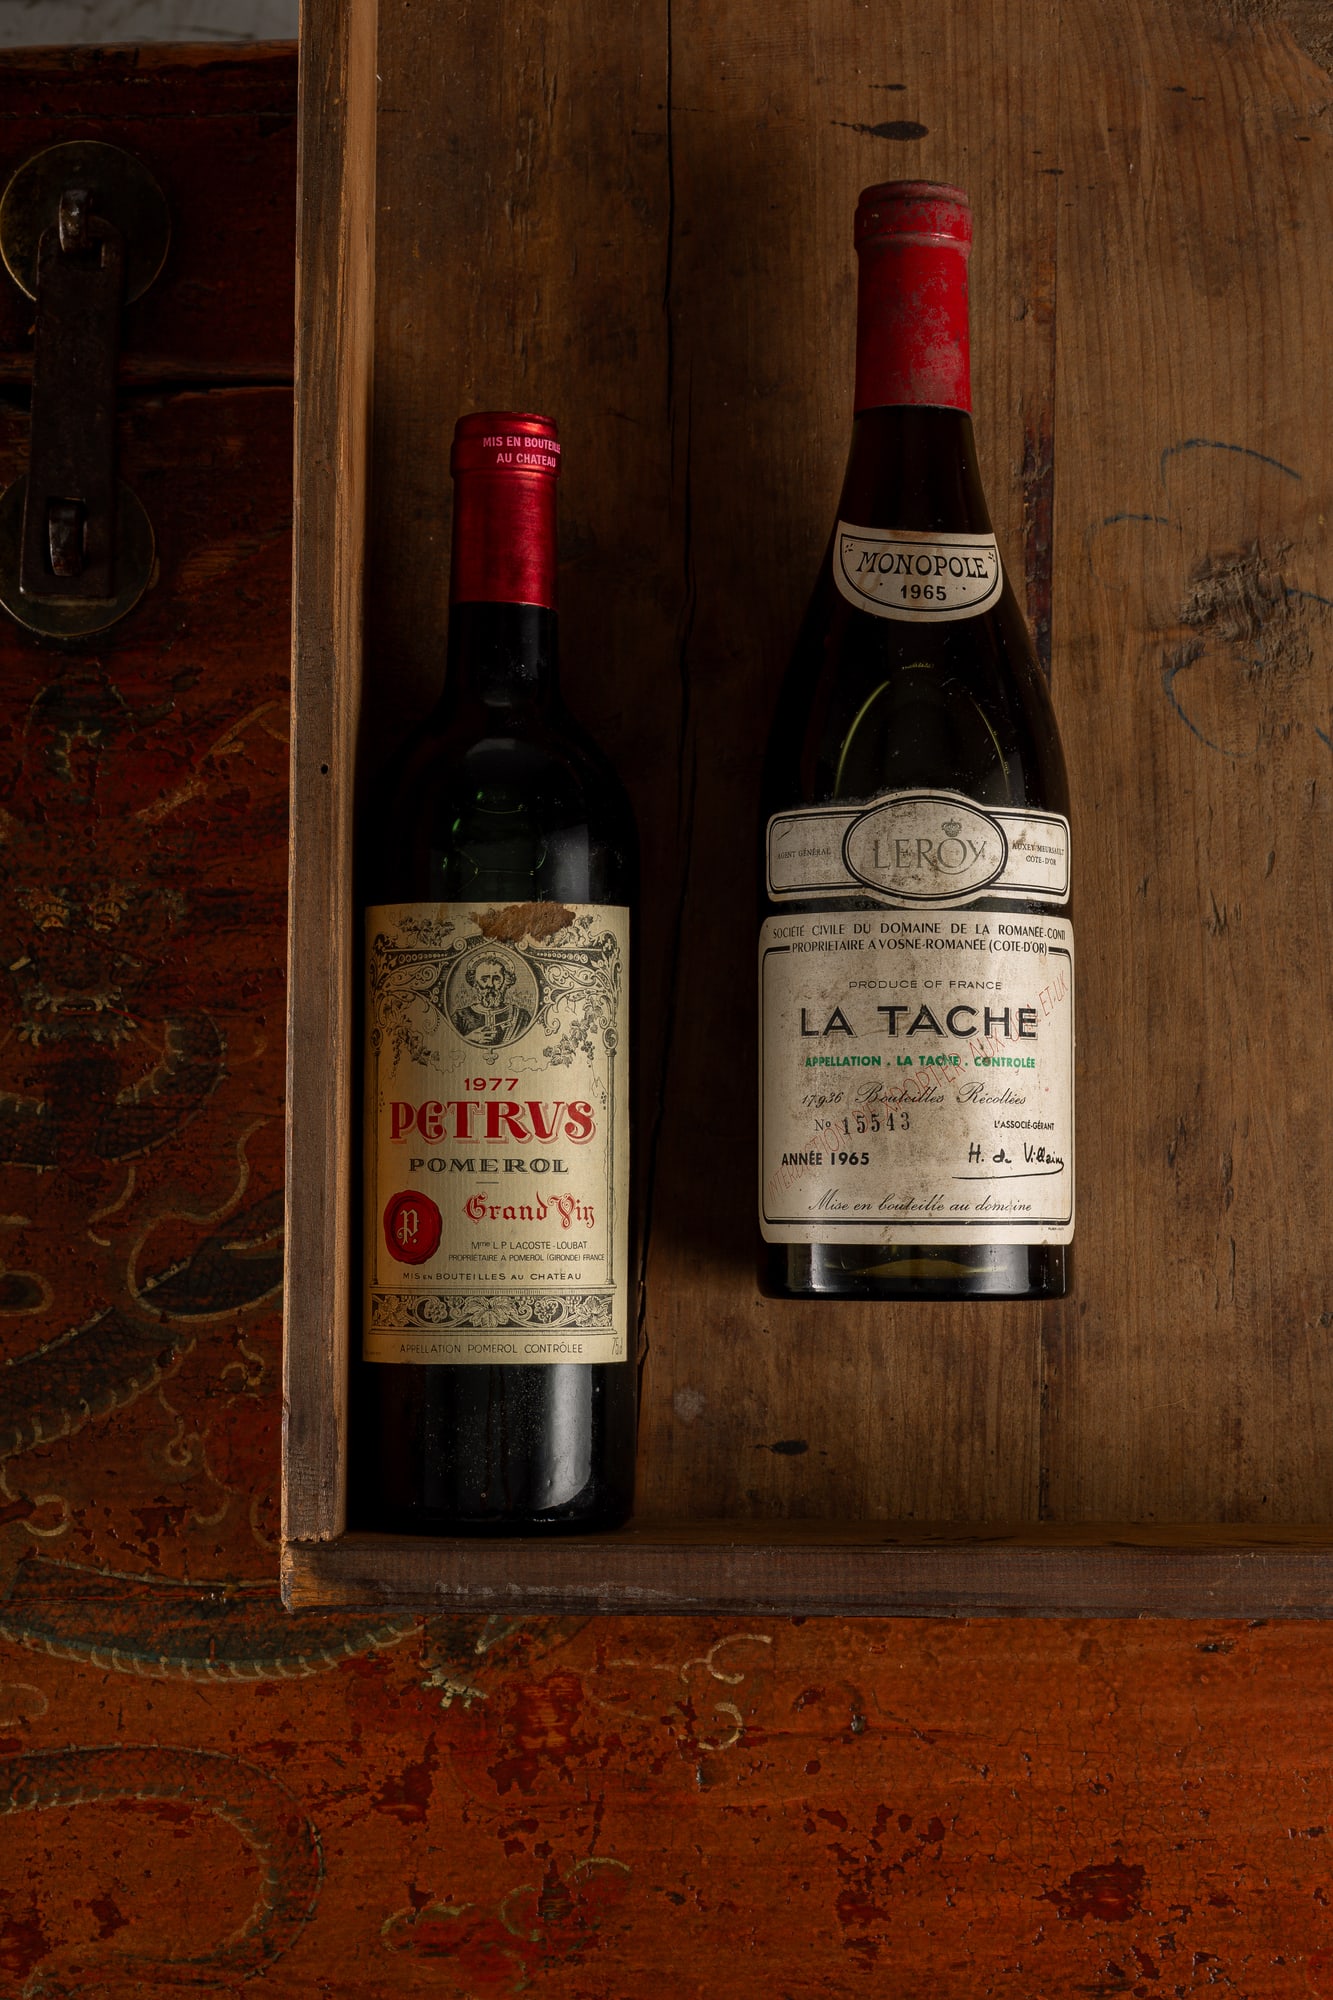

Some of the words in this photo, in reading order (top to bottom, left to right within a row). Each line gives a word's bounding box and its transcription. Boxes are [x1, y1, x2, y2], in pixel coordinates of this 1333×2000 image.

[483, 436, 503, 447] MIS
[506, 436, 521, 447] EN
[496, 453, 512, 464] AU
[516, 453, 556, 467] CHATEAU
[855, 551, 989, 579] MONOPOLE
[900, 584, 947, 600] 1965
[777, 850, 797, 860] AGENT
[872, 837, 988, 875] LEROY
[773, 925, 805, 939] SOCIÉTÉ
[811, 923, 846, 936] CIVILE
[853, 923, 871, 934] DU
[880, 922, 941, 934] DOMAINE
[950, 923, 967, 934] DE
[975, 924, 990, 935] LA
[878, 938, 986, 951] VOSNE-ROMANÉE
[849, 980, 918, 989] PRODUCE
[924, 980, 943, 989] OF
[949, 980, 1002, 990] FRANCE
[801, 1006, 858, 1039] LA
[877, 1003, 1038, 1041] TACHE
[804, 1055, 882, 1067] APPELLATION
[896, 1055, 913, 1067] LA
[918, 1055, 959, 1067] TACHE
[464, 1077, 519, 1091] 1977
[854, 1081, 945, 1105] Bouteilles
[956, 1081, 1026, 1105] Récoltées
[843, 1111, 911, 1136] 15543
[994, 1119, 1055, 1131] L'ASSOCIÉ-GÉRANT
[408, 1157, 569, 1174] POMEROL
[781, 1150, 823, 1166] ANNÉE
[831, 1152, 870, 1166] 1965
[807, 1187, 850, 1211] Mise
[853, 1202, 872, 1211] en
[878, 1193, 945, 1211] bouteille
[949, 1202, 970, 1211] au
[461, 1191, 548, 1225] Grand
[548, 1192, 595, 1230] Vin
[508, 1254, 545, 1262] POMEROL
[546, 1254, 581, 1262] (GIRONDE)
[403, 1272, 421, 1280] MIS
[435, 1272, 506, 1281] BOUTEILLES
[400, 1343, 461, 1354] APPELLATION
[467, 1344, 519, 1354] POMEROL
